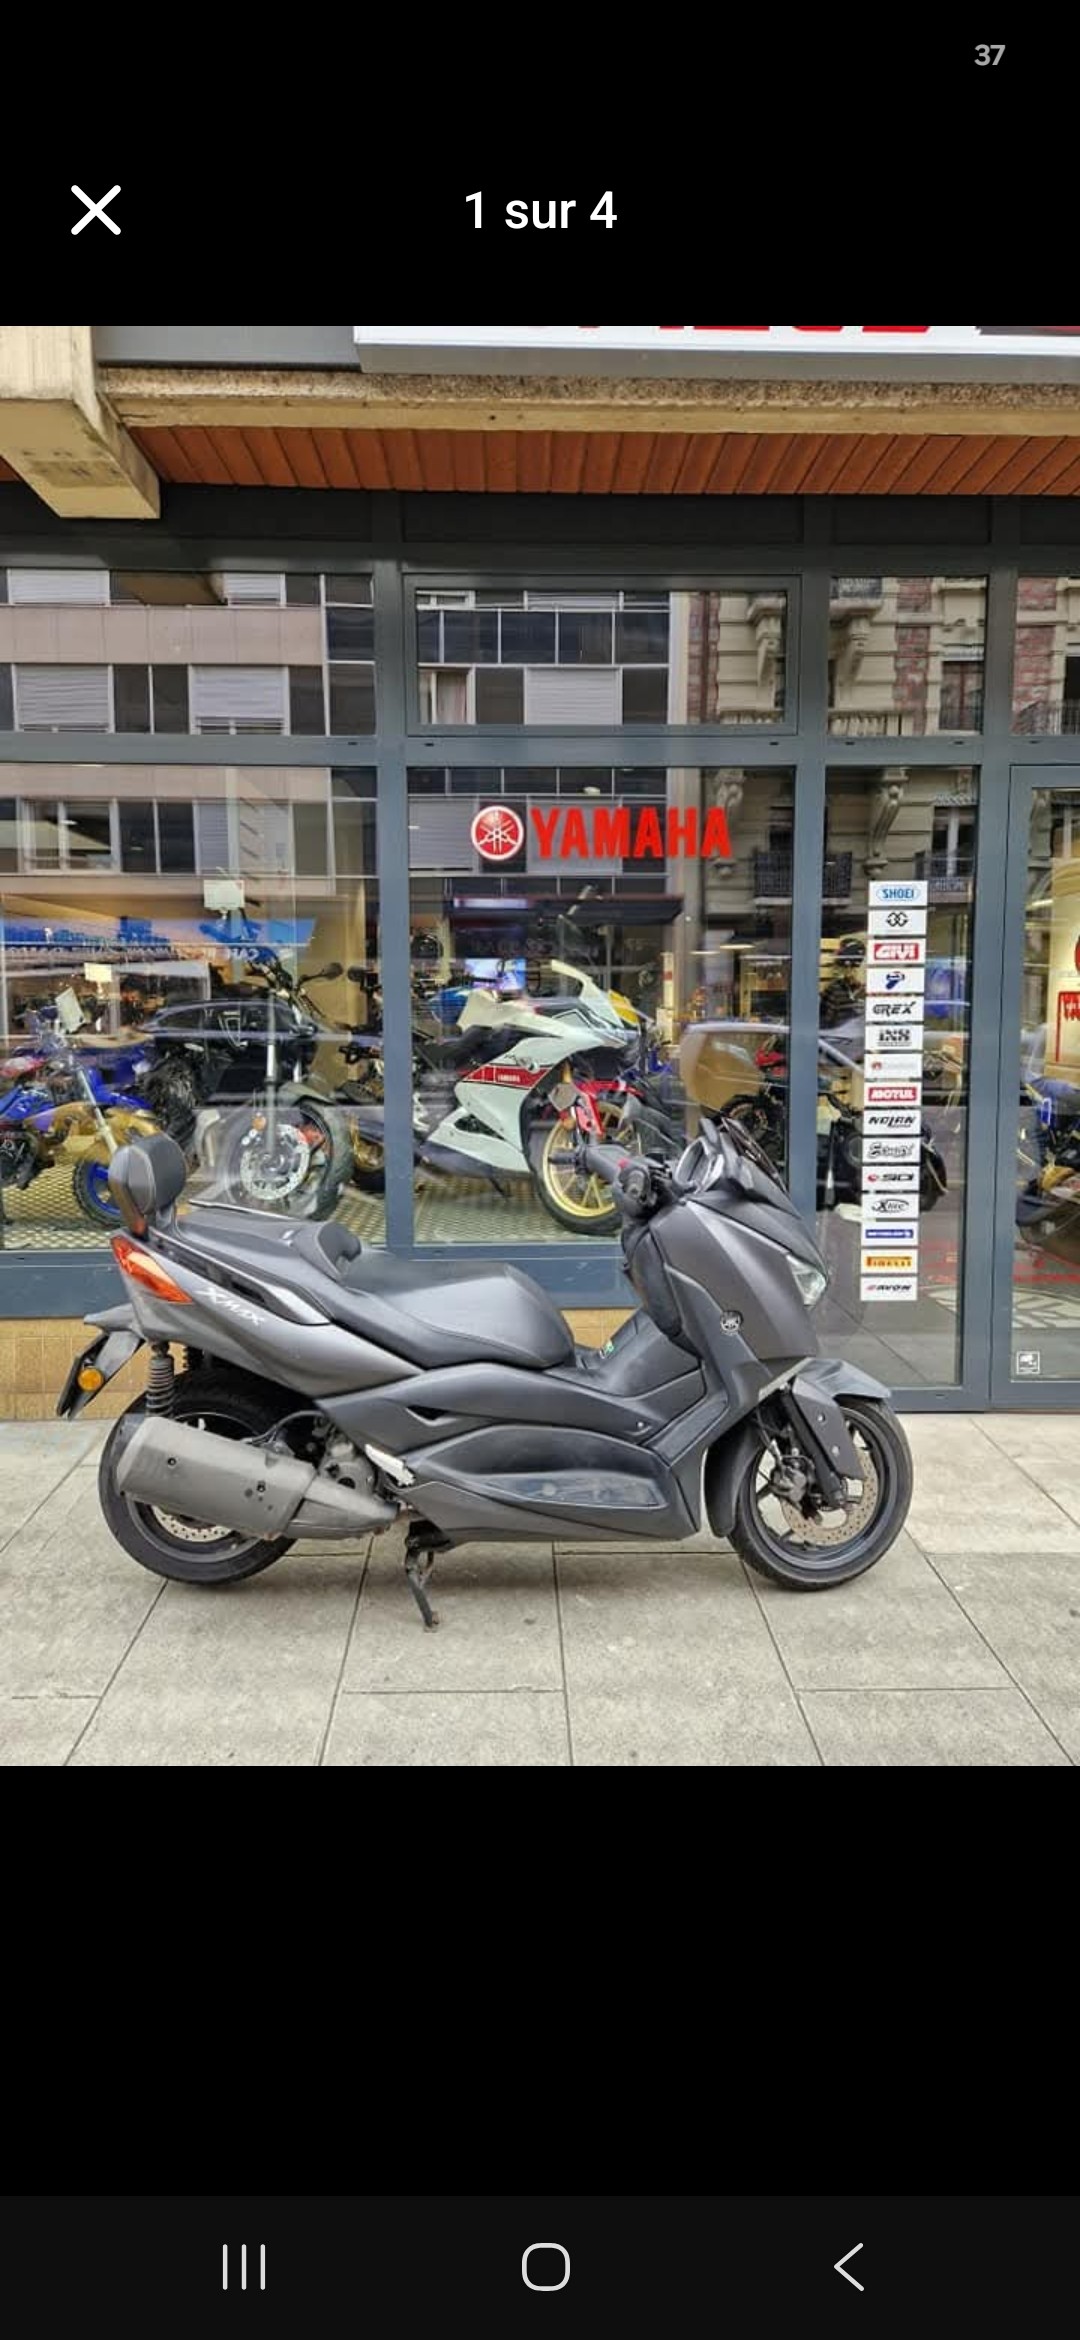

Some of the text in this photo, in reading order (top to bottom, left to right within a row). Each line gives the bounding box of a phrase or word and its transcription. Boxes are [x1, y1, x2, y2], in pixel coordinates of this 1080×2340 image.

[530, 807, 732, 860] YAMAHA
[882, 888, 914, 899] SHOEI
[876, 944, 917, 959] GIVI
[871, 1088, 916, 1100] MOTUL
[868, 1116, 916, 1128] NOLAN
